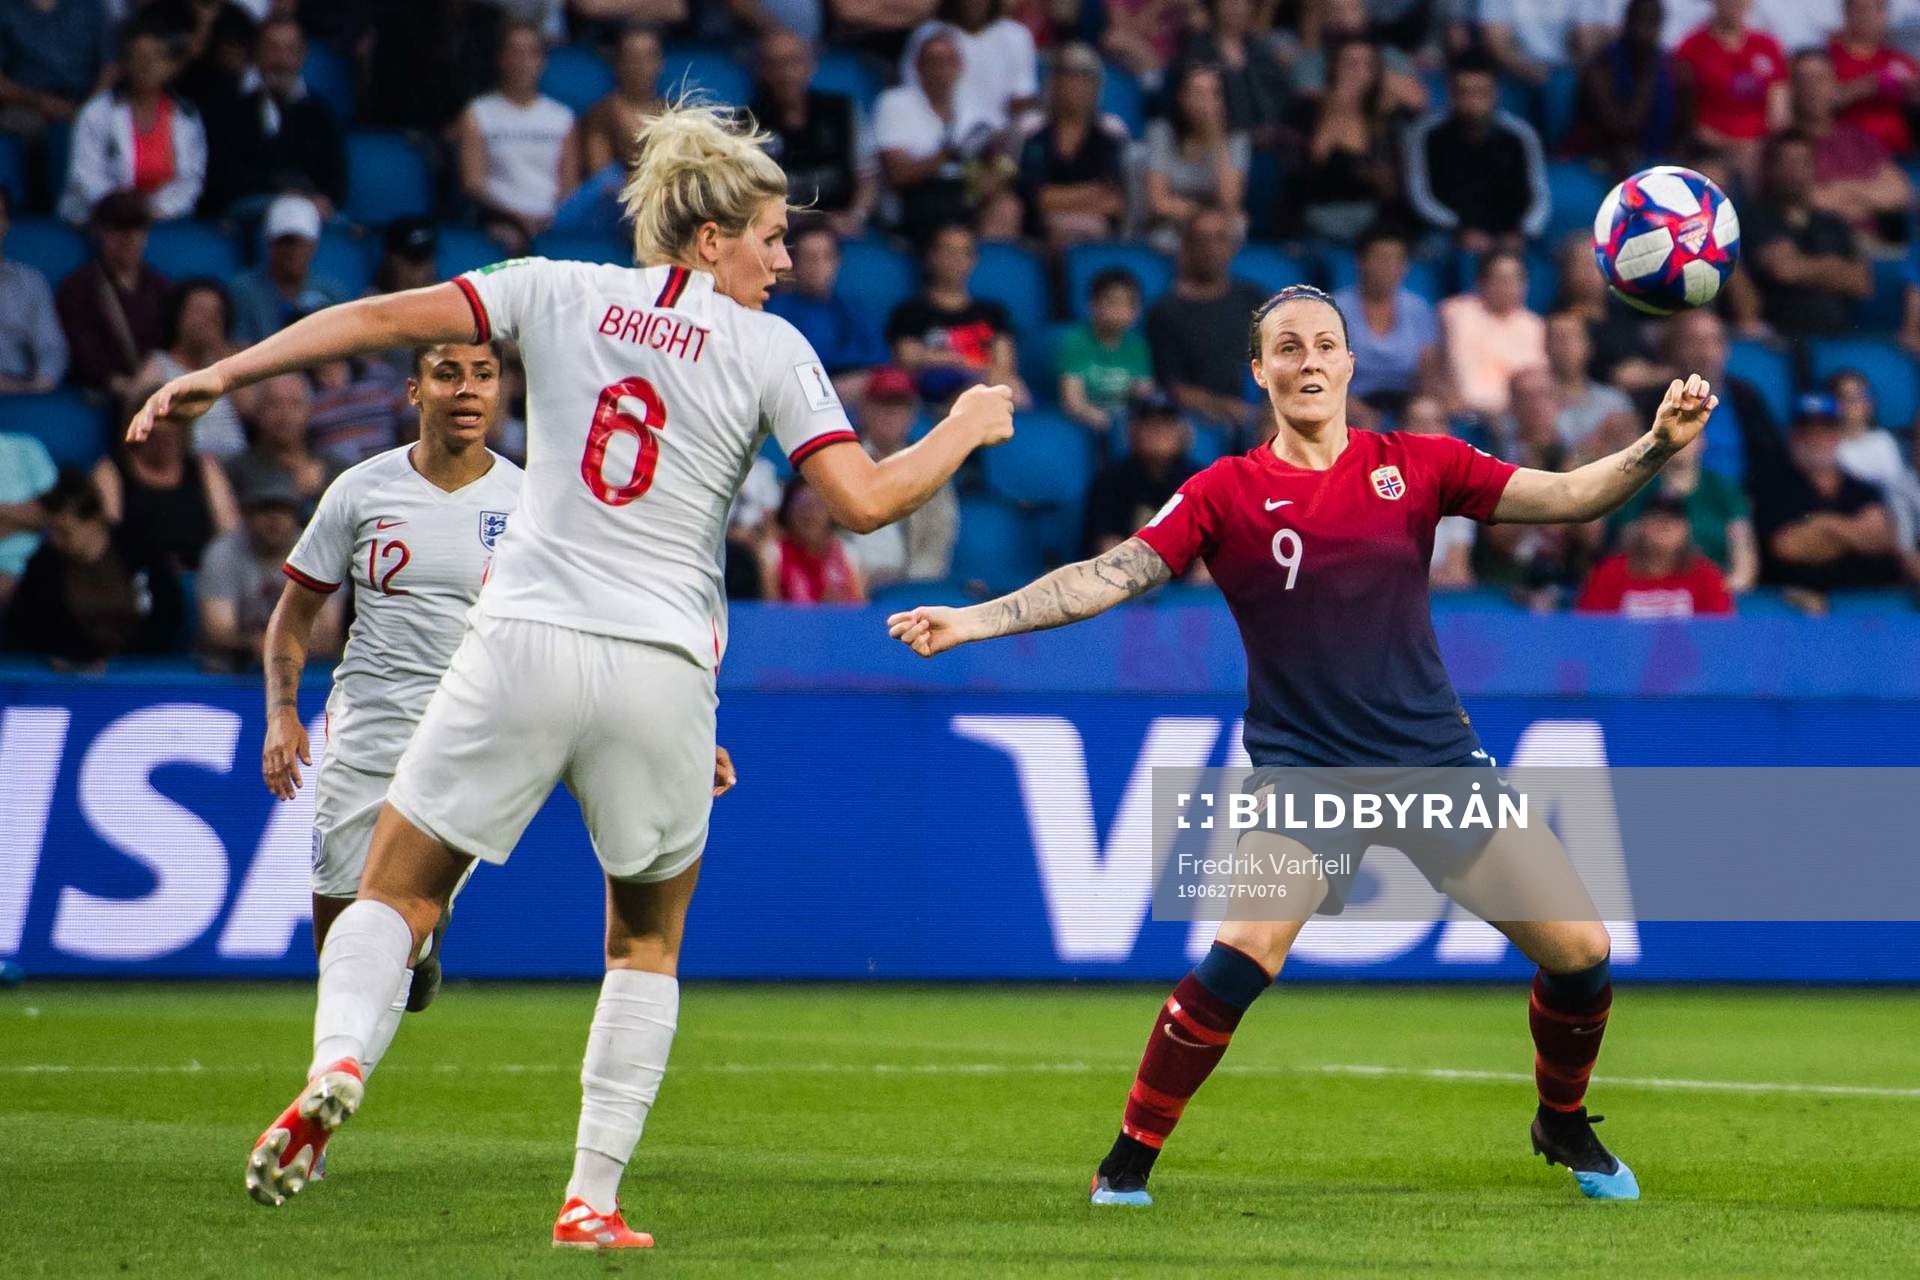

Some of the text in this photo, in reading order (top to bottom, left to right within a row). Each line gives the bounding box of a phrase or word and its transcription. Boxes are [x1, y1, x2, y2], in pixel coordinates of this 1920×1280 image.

[598, 304, 711, 363] BRIGHT
[579, 376, 668, 508] 6
[368, 538, 411, 596] 12
[1271, 527, 1304, 591] 9
